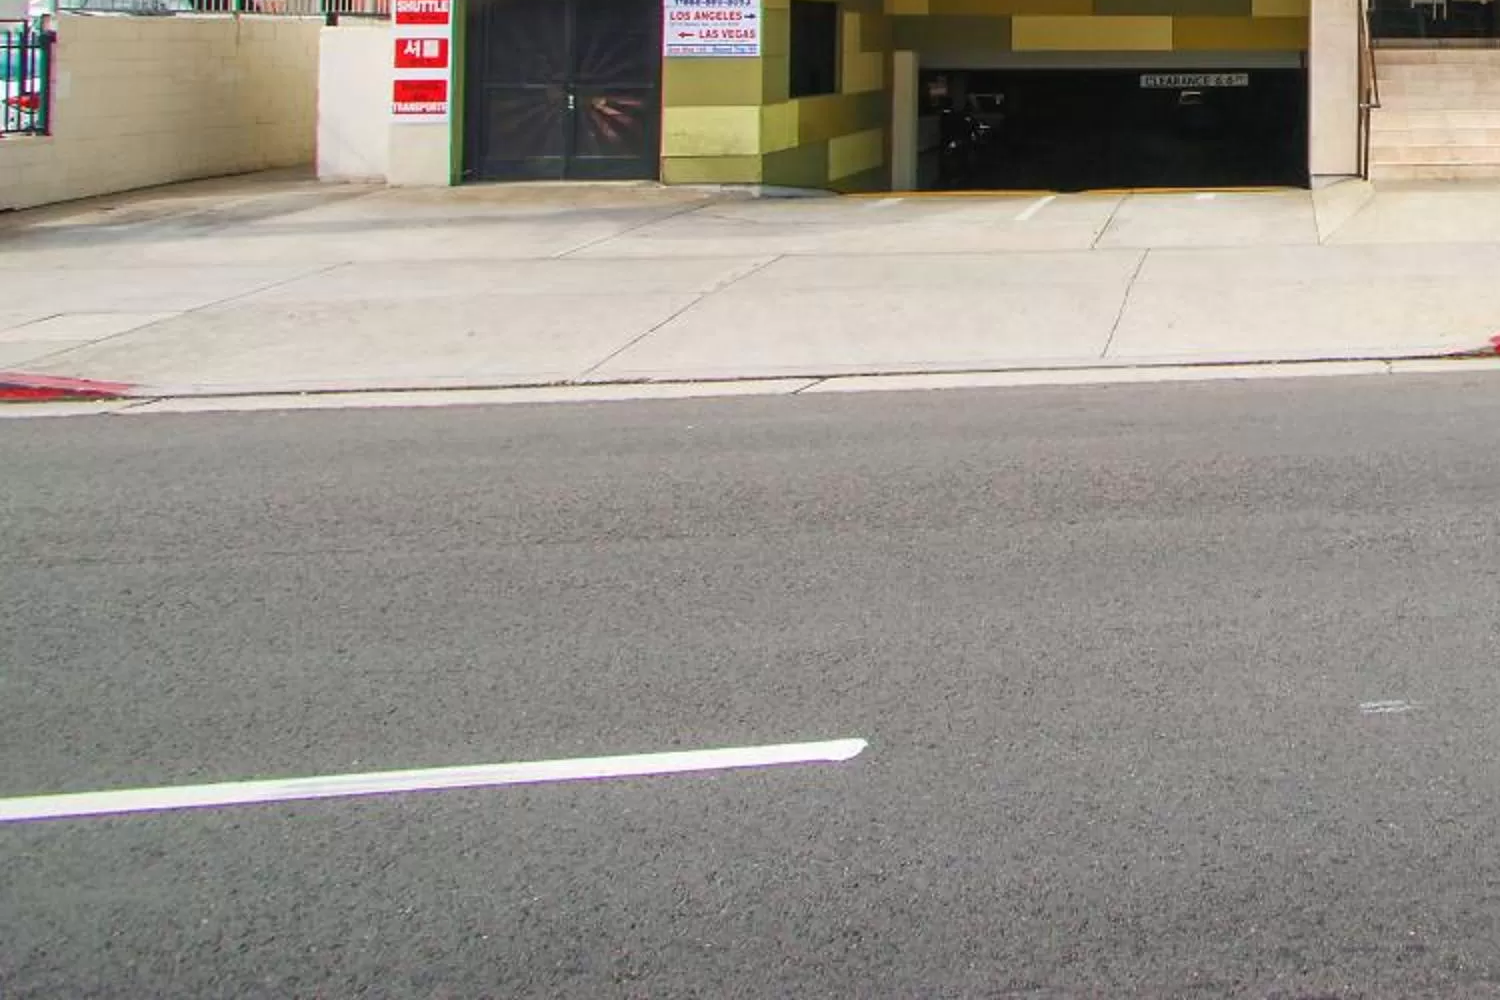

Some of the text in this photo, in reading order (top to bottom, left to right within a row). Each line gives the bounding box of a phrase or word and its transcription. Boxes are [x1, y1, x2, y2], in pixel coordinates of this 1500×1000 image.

[396, 0, 449, 13] SHUTTLE
[671, 11, 743, 21] LOS ANGELES
[699, 29, 756, 39] LAS VEGAS
